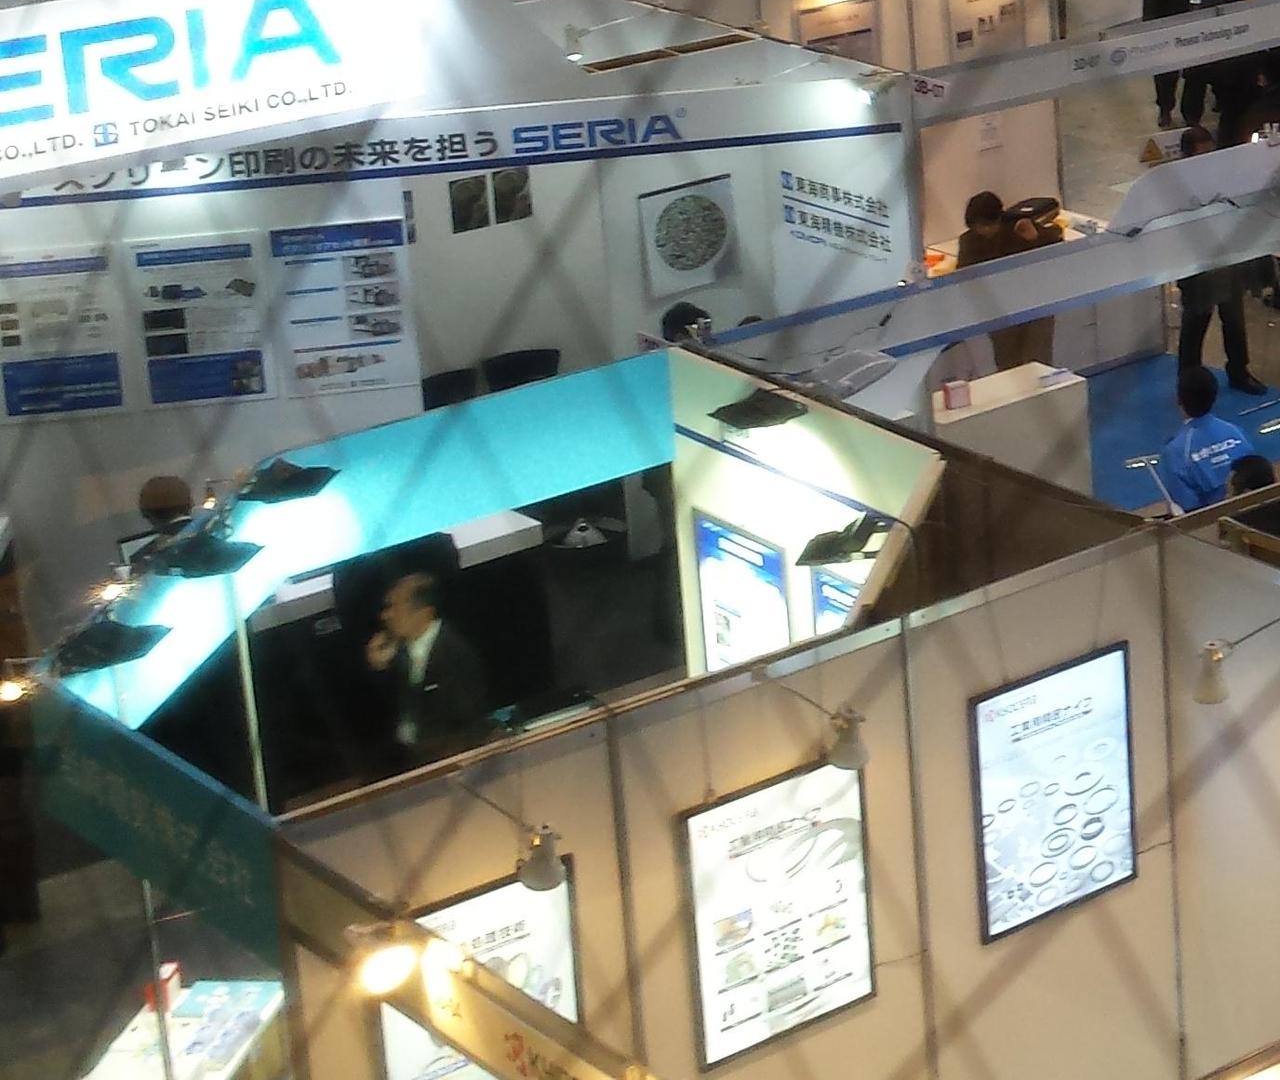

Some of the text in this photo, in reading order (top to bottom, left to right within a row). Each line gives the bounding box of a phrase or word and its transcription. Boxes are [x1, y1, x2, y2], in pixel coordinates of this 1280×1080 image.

[0, 131, 84, 162] O.,LTD.
[129, 113, 197, 138] TOKAI
[204, 99, 261, 122] SEIKI
[512, 113, 682, 155] SERIA
